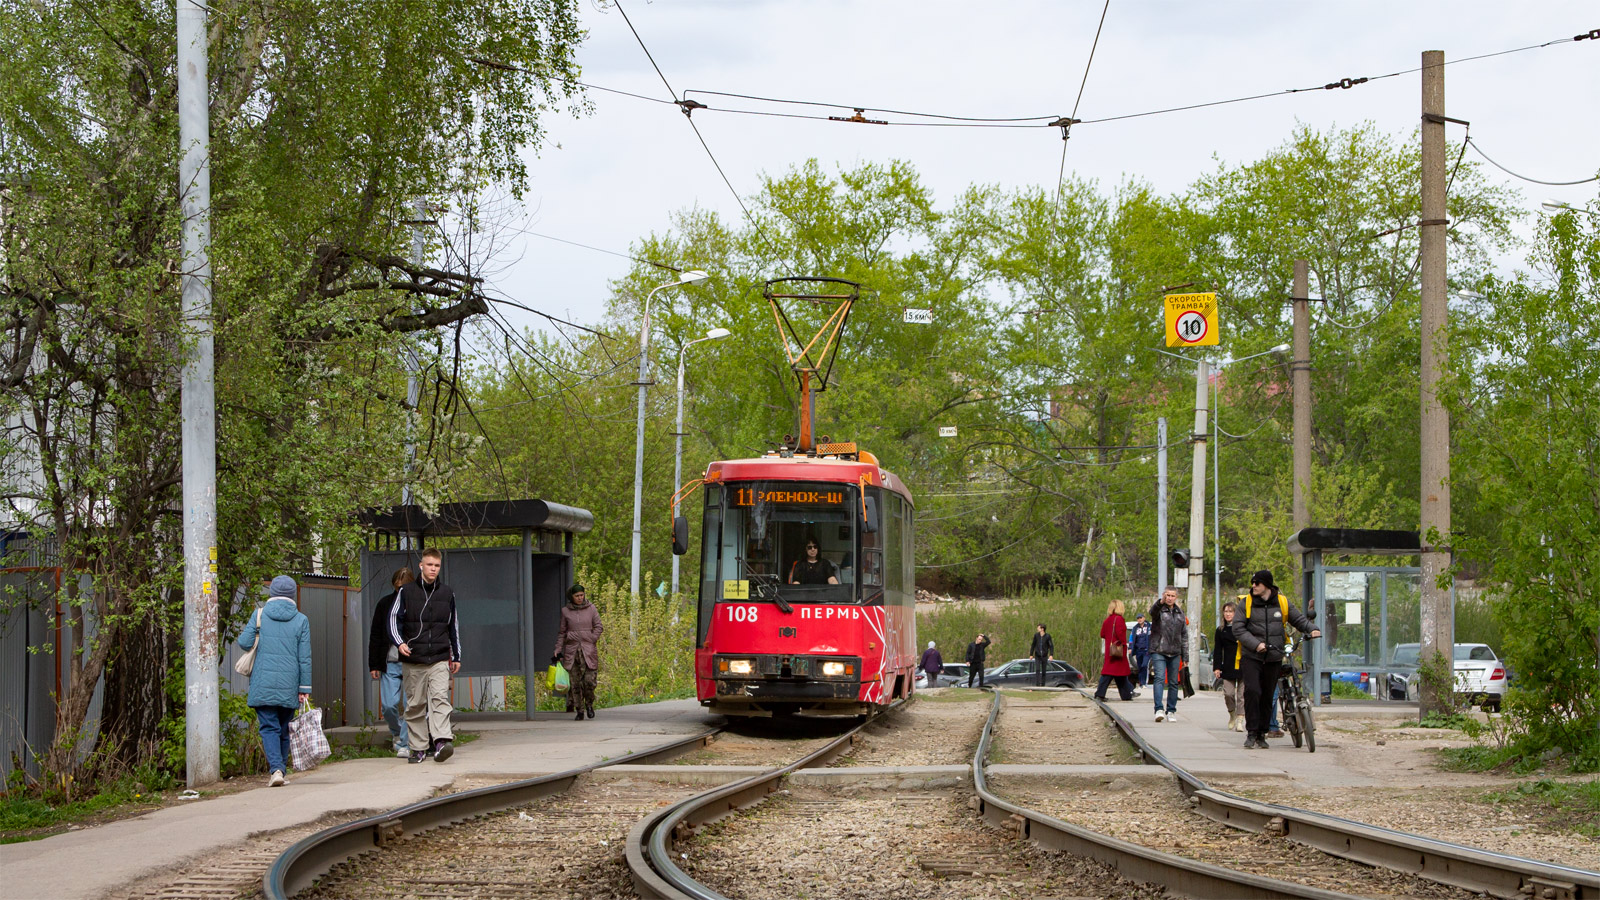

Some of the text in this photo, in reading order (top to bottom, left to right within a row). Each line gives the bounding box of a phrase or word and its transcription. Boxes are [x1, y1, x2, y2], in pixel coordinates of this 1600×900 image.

[1168, 295, 1212, 303] СКОРОСТЬ
[1171, 302, 1210, 310] ТРАМВАЯ
[904, 311, 913, 320] 15
[1182, 319, 1201, 336] 10
[736, 488, 756, 506] 11
[726, 605, 758, 622] 108
[801, 607, 860, 619] ПЕРМЬ
